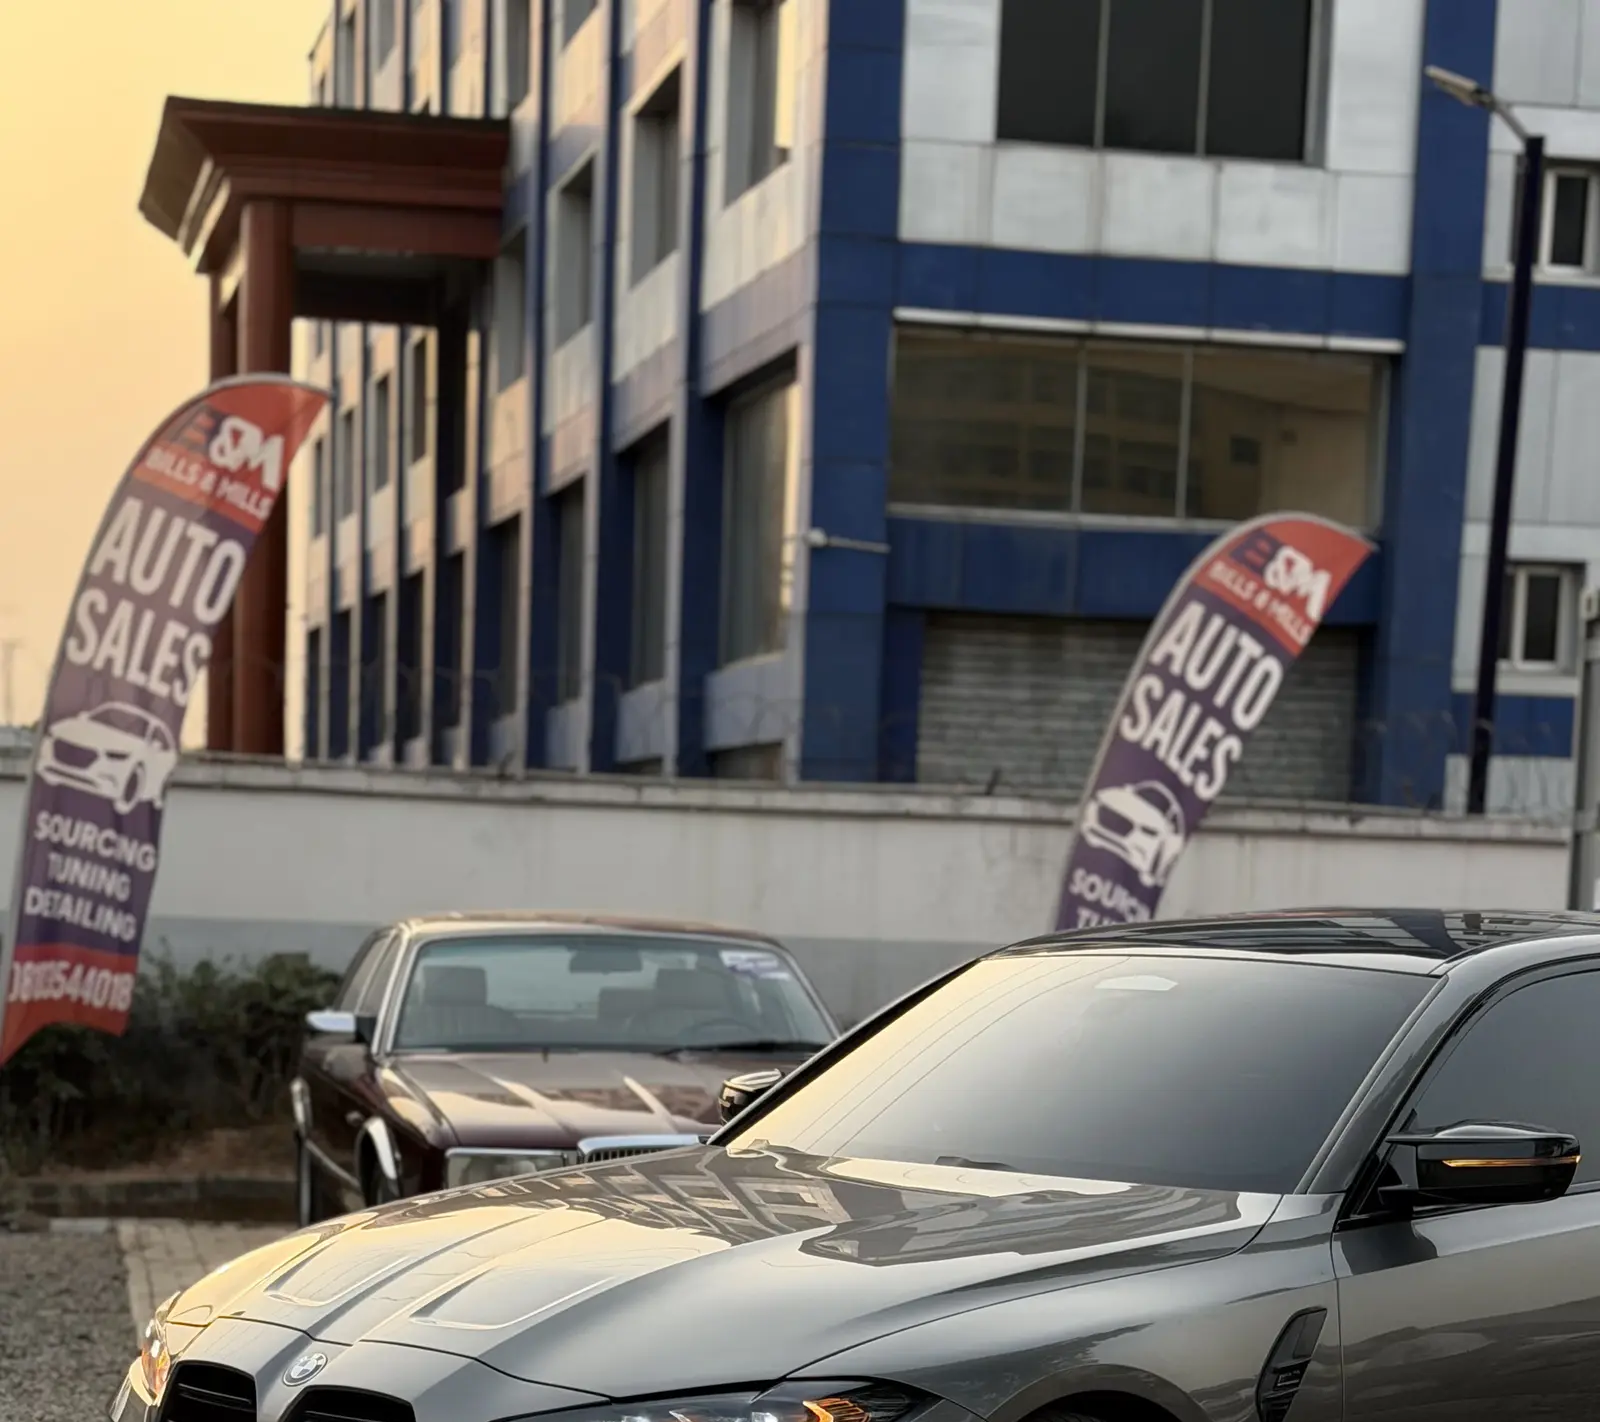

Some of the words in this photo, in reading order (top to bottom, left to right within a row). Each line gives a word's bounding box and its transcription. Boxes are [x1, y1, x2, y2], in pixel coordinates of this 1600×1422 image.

[89, 496, 246, 626] AUTO
[65, 587, 213, 708] SALES
[1150, 599, 1284, 731] AUTO
[1118, 674, 1243, 801] SALES
[33, 809, 158, 873] SOURCING
[47, 852, 132, 903] TUNING
[23, 885, 138, 943] DETAILING
